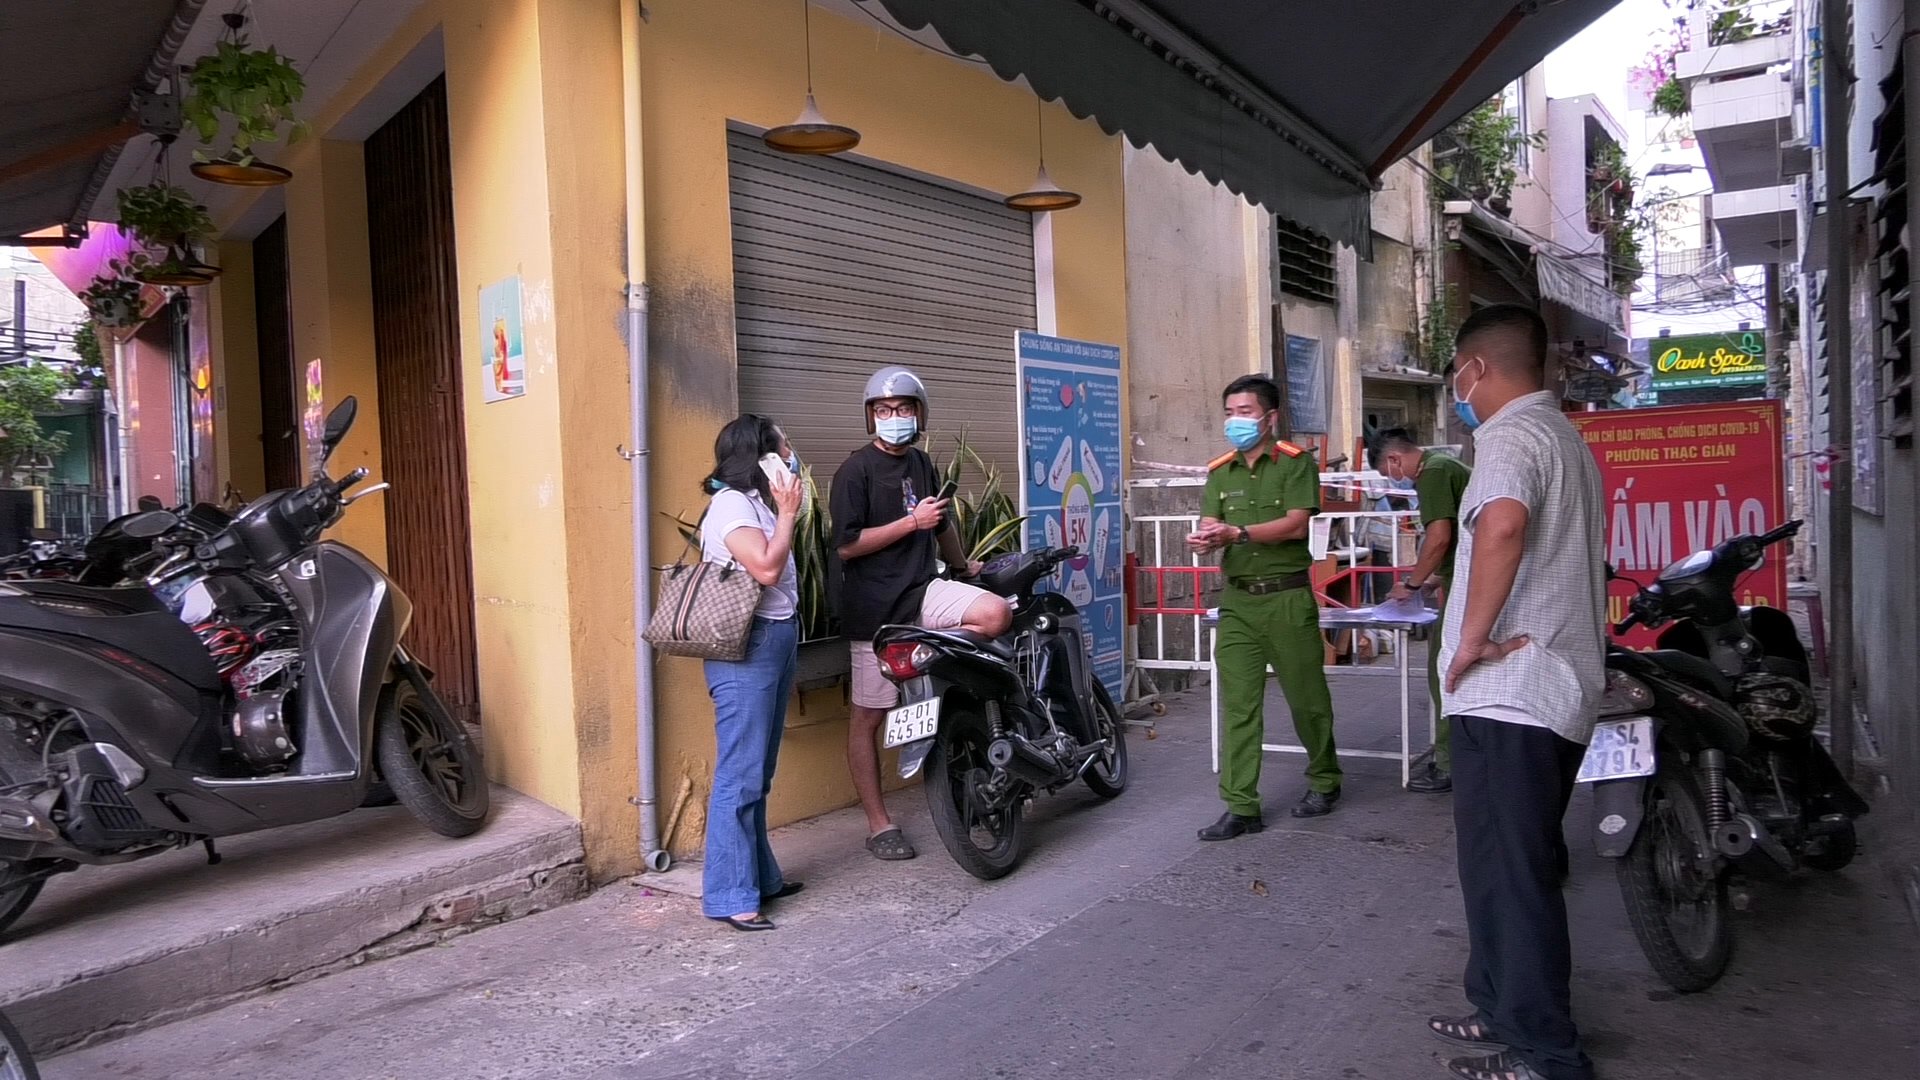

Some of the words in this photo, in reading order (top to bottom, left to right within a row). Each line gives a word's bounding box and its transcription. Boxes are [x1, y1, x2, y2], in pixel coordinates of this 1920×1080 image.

[1658, 347, 1706, 372] Oanh
[1709, 348, 1752, 375] Spa
[1583, 431, 1600, 444] BAN
[1601, 426, 1615, 442] CHỈ
[1617, 429, 1633, 444] ĐẠO
[1635, 425, 1666, 441] PHÒNG,
[1667, 421, 1696, 439] CHỐNG
[1697, 423, 1718, 440] DỊCH
[1720, 421, 1760, 436] COVID-19
[1605, 446, 1660, 463] PHƯỜNG
[1663, 446, 1698, 462] THẠC
[1071, 517, 1087, 544] 5K
[1604, 477, 1672, 571] ẤM
